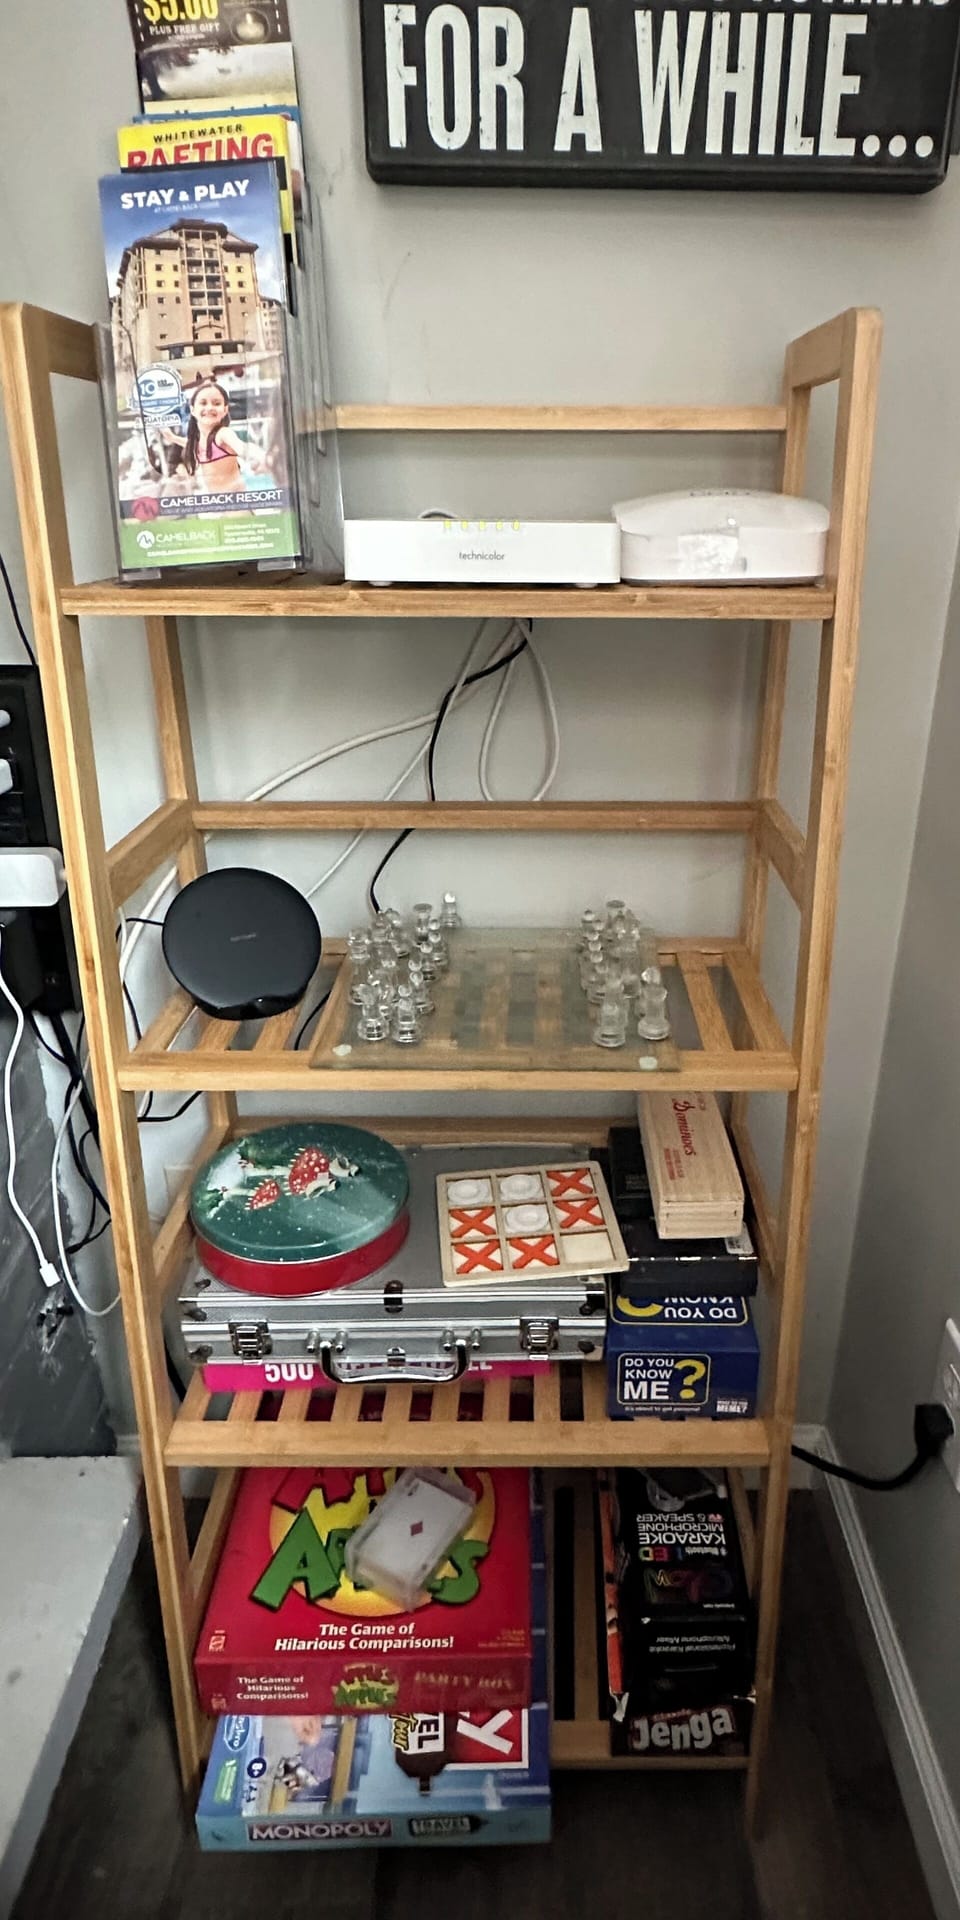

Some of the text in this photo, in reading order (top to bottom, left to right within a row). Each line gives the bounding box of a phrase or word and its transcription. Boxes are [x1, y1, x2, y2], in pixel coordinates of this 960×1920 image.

[144, 0, 219, 25] $5.00
[150, 22, 220, 36] PLUS FREE GIFT
[383, 4, 934, 157] FOR A WHILE...
[154, 124, 243, 144] WHITEWATER
[128, 133, 274, 168] RAFTING
[120, 188, 174, 210] STAY
[194, 180, 250, 201] PLAY
[160, 494, 234, 508] CAMELBACK
[236, 490, 283, 503] RESORT
[458, 551, 505, 560] technicolor
[672, 1098, 697, 1156] Dominoes
[664, 1307, 738, 1320] DO YOU
[624, 1358, 674, 1368] DO YOU
[265, 1362, 314, 1382] 500
[624, 1369, 672, 1380] KNOW
[624, 1380, 670, 1400] ME
[637, 1514, 694, 1522] SPEAKER
[638, 1522, 724, 1532] MICROPHONE
[639, 1532, 726, 1545] KARAOKE
[320, 1622, 416, 1636] The Game of
[274, 1636, 454, 1652] Hilarious Comparisons!
[236, 1692, 308, 1700] Comparisons!
[632, 1708, 734, 1750] Jenga
[252, 1821, 388, 1840] MONOPOLY
